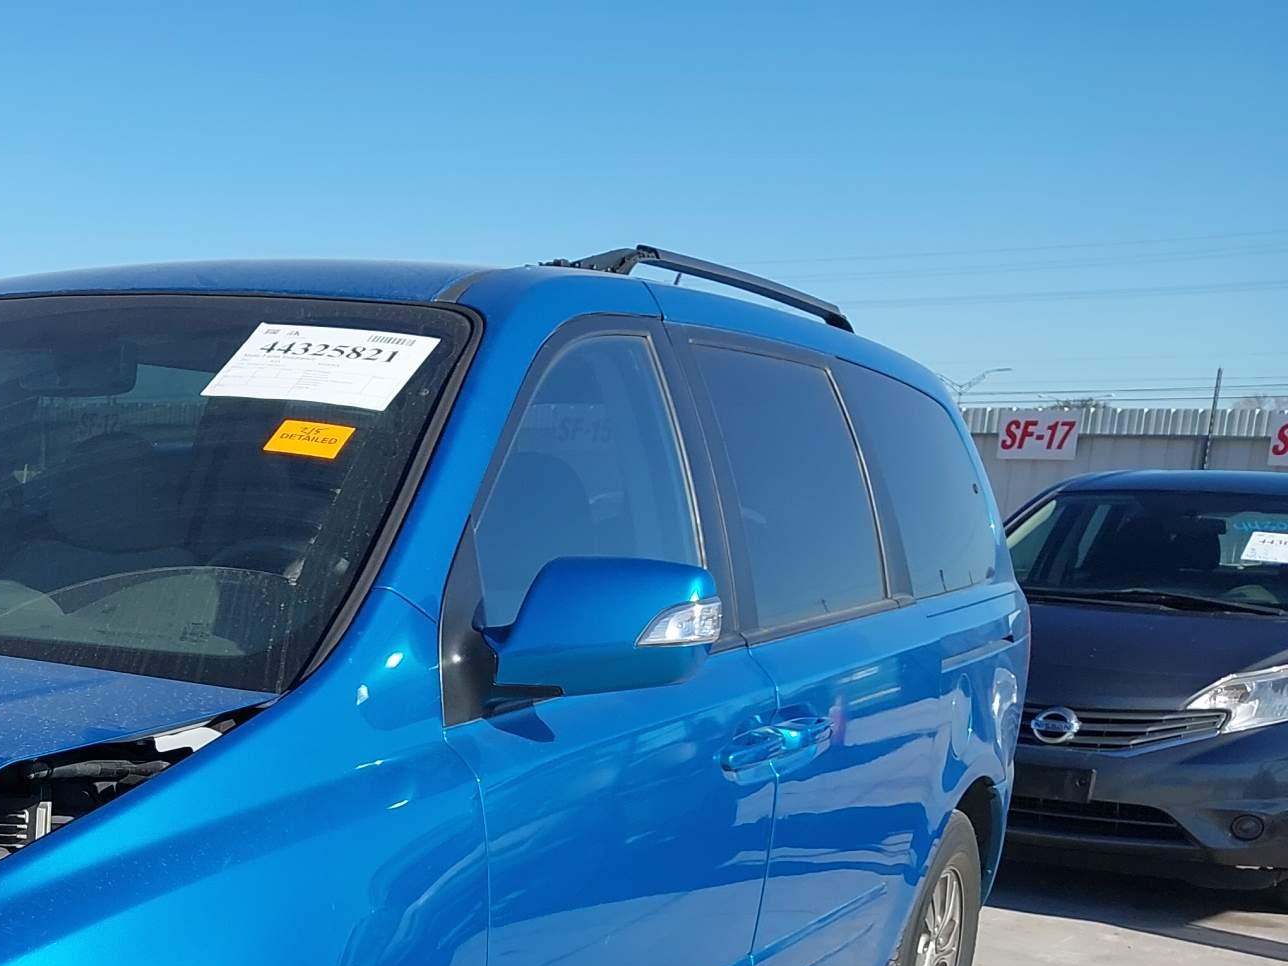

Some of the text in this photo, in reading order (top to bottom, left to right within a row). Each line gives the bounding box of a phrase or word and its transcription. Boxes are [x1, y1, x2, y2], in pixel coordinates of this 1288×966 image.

[260, 341, 399, 363] 44325821
[280, 432, 338, 445] DETAILED
[1000, 420, 1076, 450] SF-17
